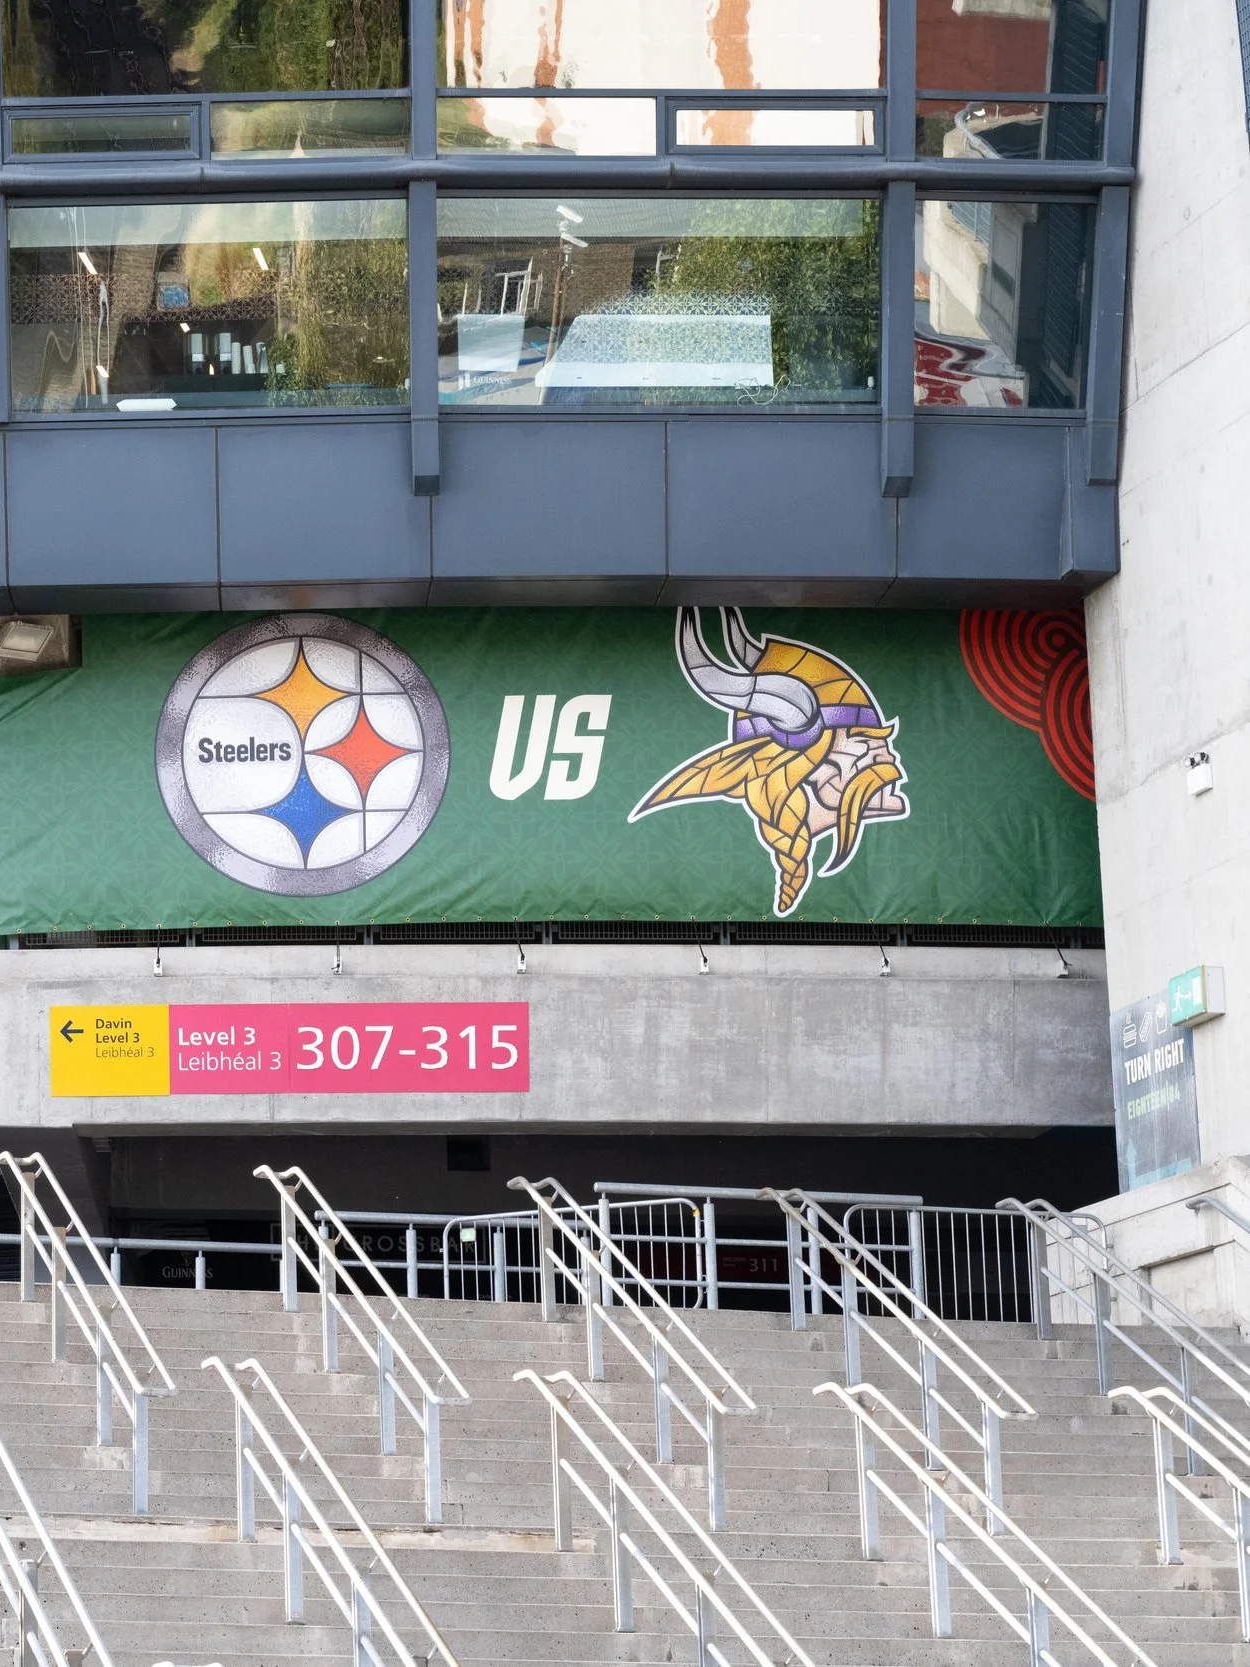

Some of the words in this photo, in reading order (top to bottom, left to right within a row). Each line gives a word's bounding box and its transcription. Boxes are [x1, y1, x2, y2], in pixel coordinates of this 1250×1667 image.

[473, 375, 512, 384] GUINNESS
[198, 736, 292, 763] Steelers
[95, 1018, 132, 1029] Davin
[95, 1032, 129, 1043] Level
[133, 1032, 140, 1043] 3
[178, 1026, 235, 1046] Level
[243, 1027, 256, 1045] 3
[95, 1046, 144, 1058] Leibhéal
[147, 1047, 155, 1058] 3
[296, 1025, 518, 1070] 307-315
[178, 1051, 261, 1071] Leibhéal
[269, 1051, 281, 1070] 3
[1124, 1053, 1151, 1085] TURN
[1154, 1039, 1185, 1074] RIGHT
[162, 1266, 214, 1279] GUINNS
[749, 1258, 778, 1273] 311
